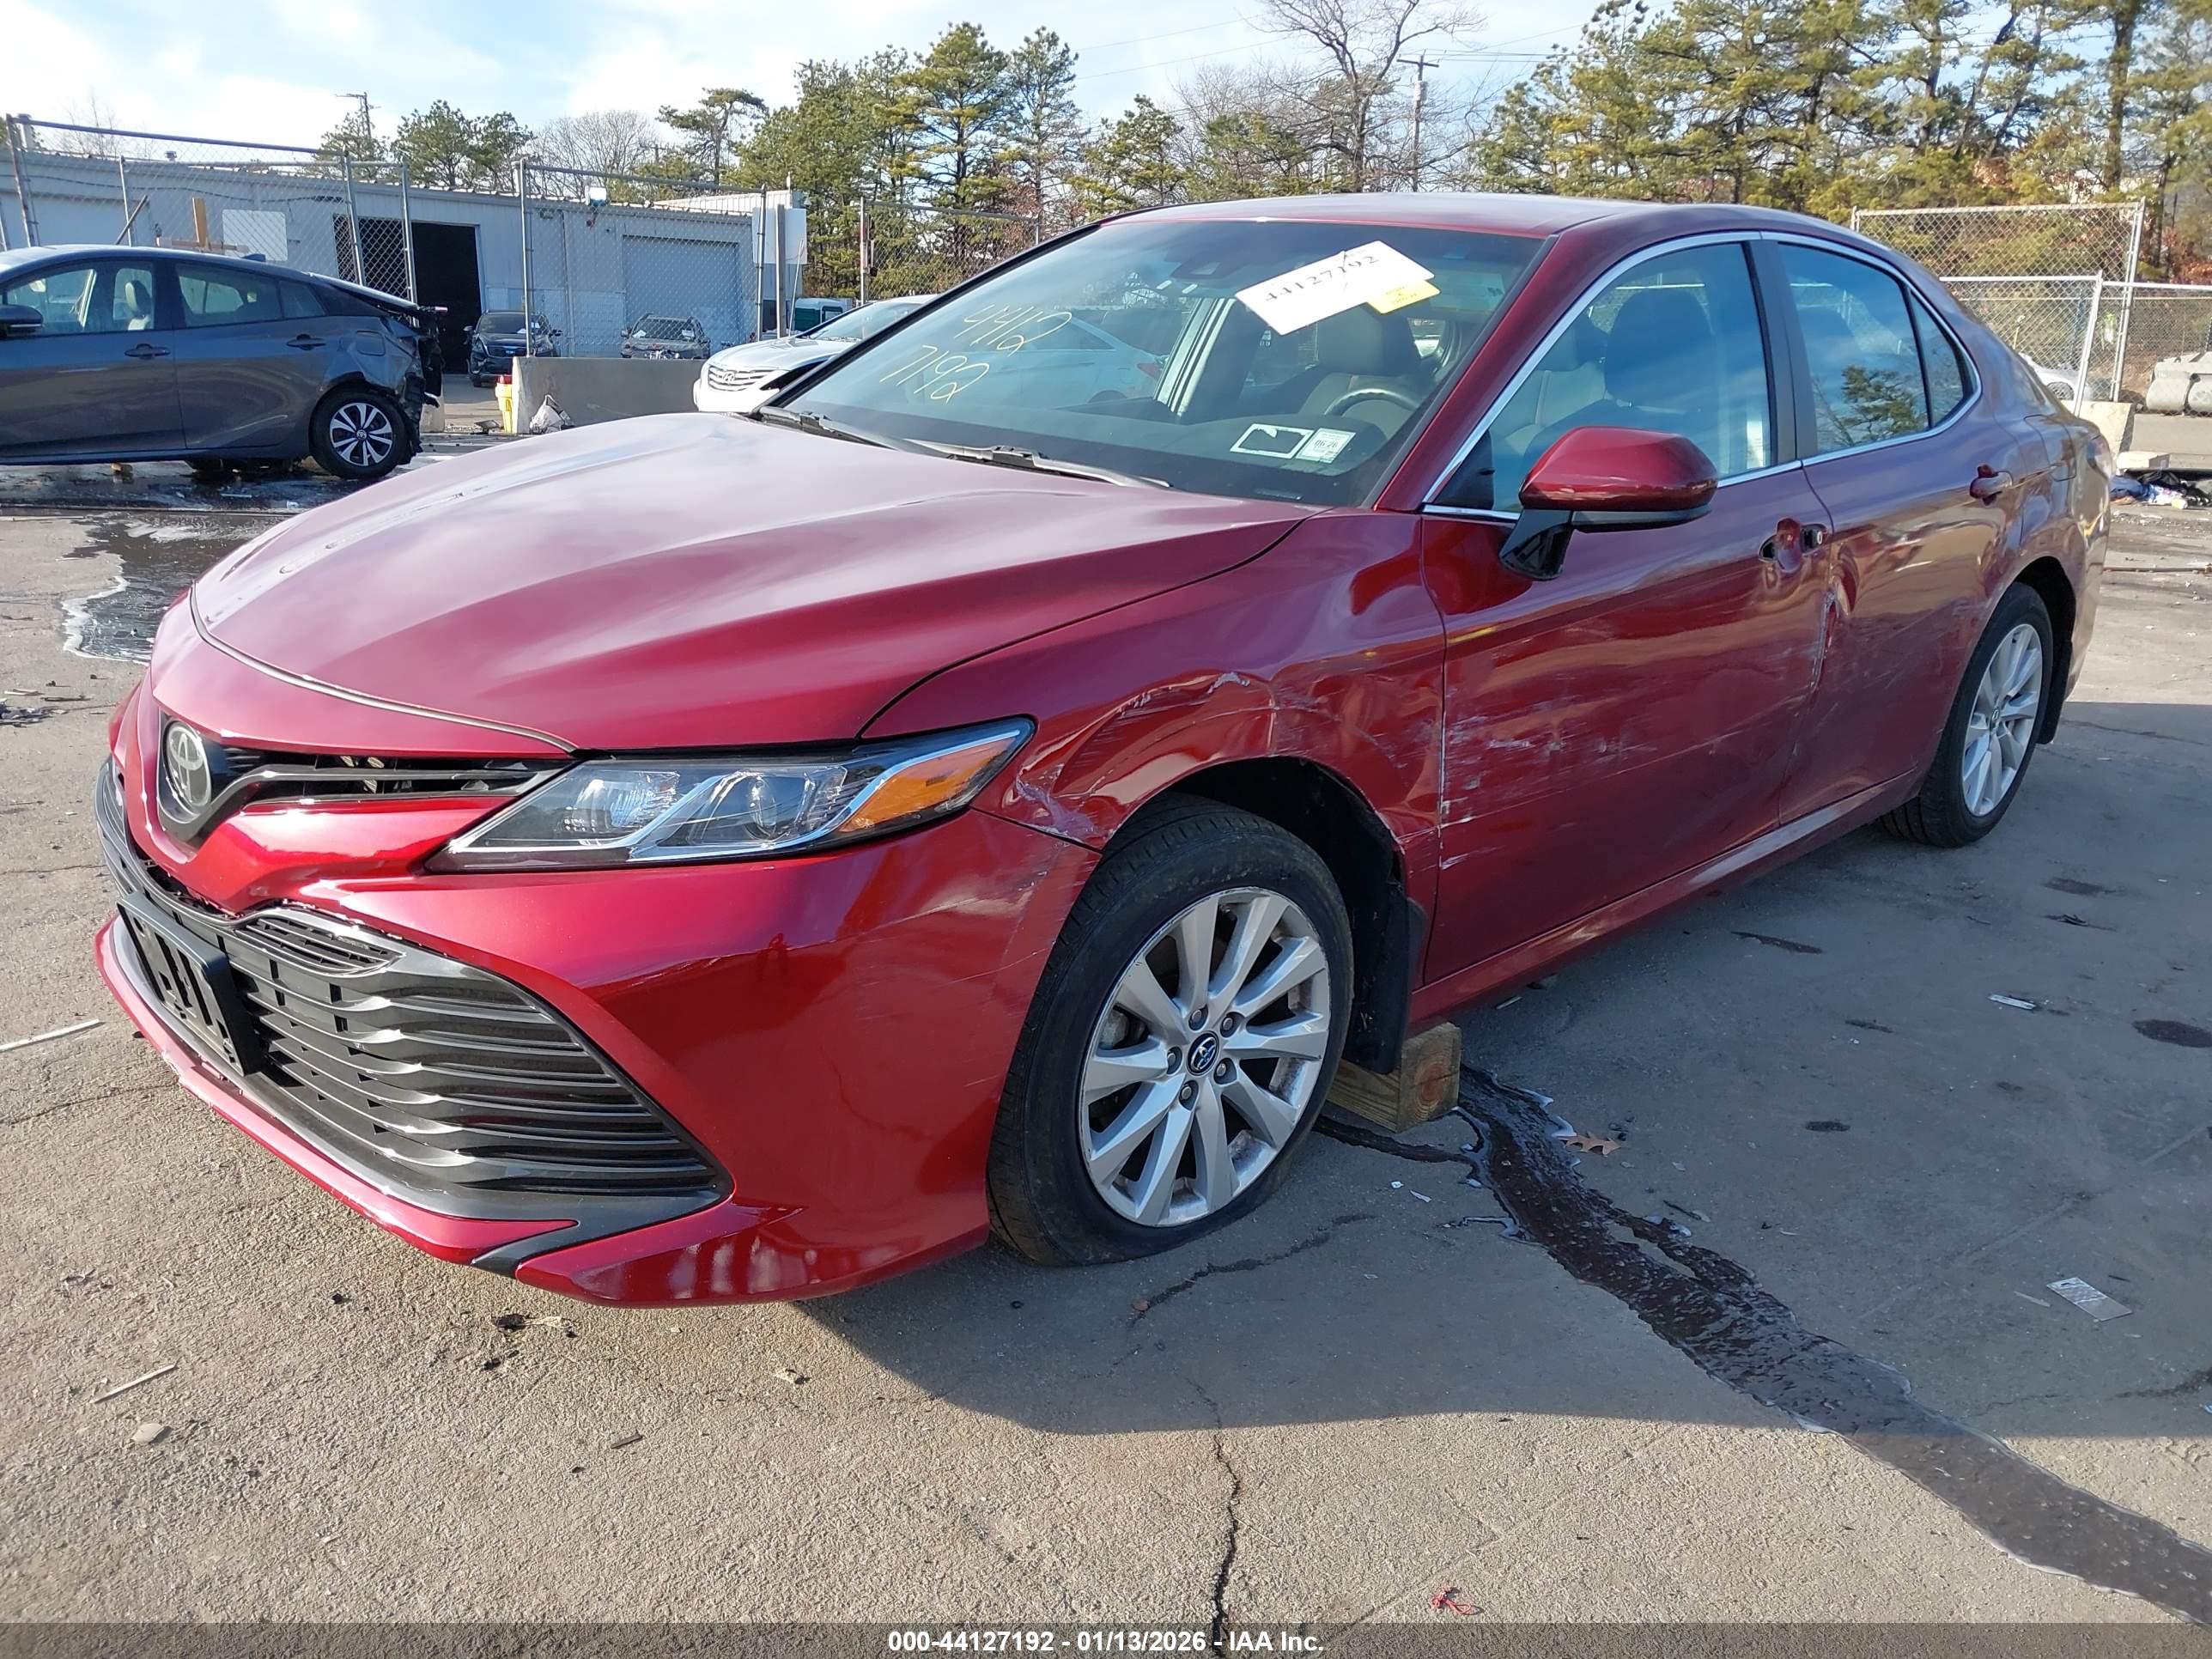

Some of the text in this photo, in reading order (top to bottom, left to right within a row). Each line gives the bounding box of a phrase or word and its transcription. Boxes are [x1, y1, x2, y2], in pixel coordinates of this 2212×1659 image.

[1265, 255, 1380, 301] 44127192
[953, 303, 1073, 357] 4412
[878, 344, 990, 404] 7192
